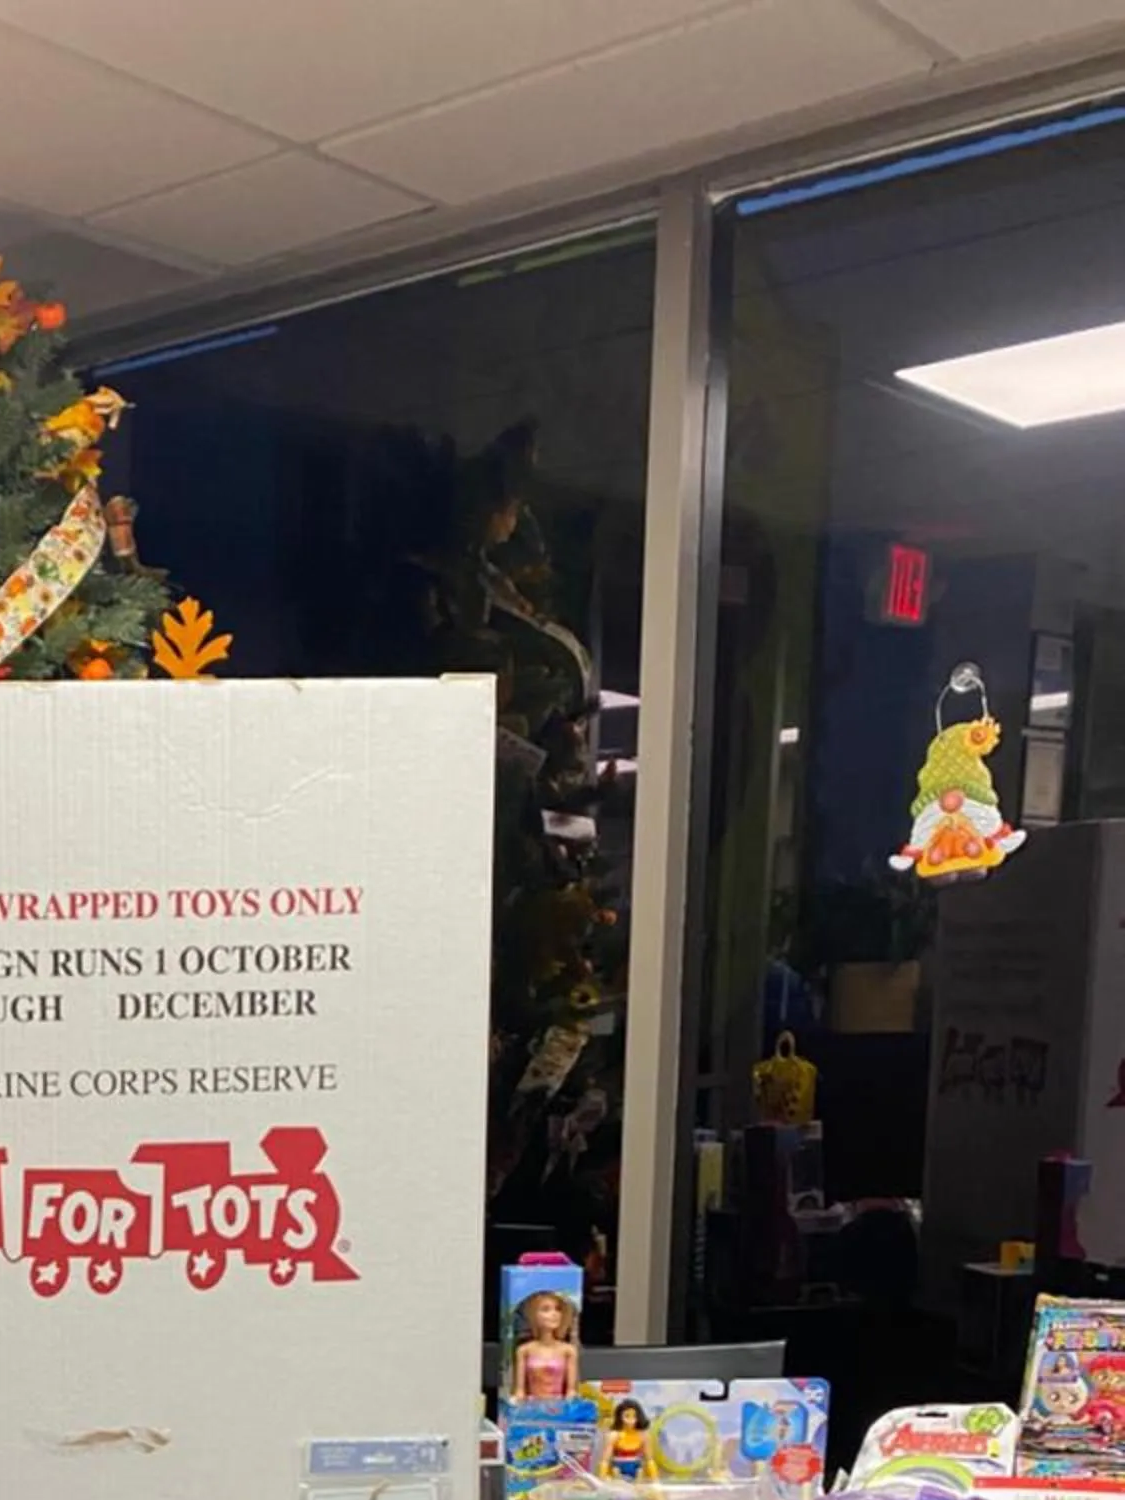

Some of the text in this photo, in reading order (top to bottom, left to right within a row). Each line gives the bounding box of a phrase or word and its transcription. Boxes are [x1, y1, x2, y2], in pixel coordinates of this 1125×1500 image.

[168, 889, 261, 919] TOYS
[270, 886, 364, 917] ONLY
[51, 948, 143, 978] RUNS
[156, 949, 166, 976] 1
[179, 944, 352, 975] OCTOBER
[117, 989, 318, 1021] DECEMBER
[69, 1069, 179, 1098] CORPS
[188, 1064, 338, 1095] RESERVE
[26, 1183, 138, 1251] FOR
[171, 1184, 319, 1252] TOTS
